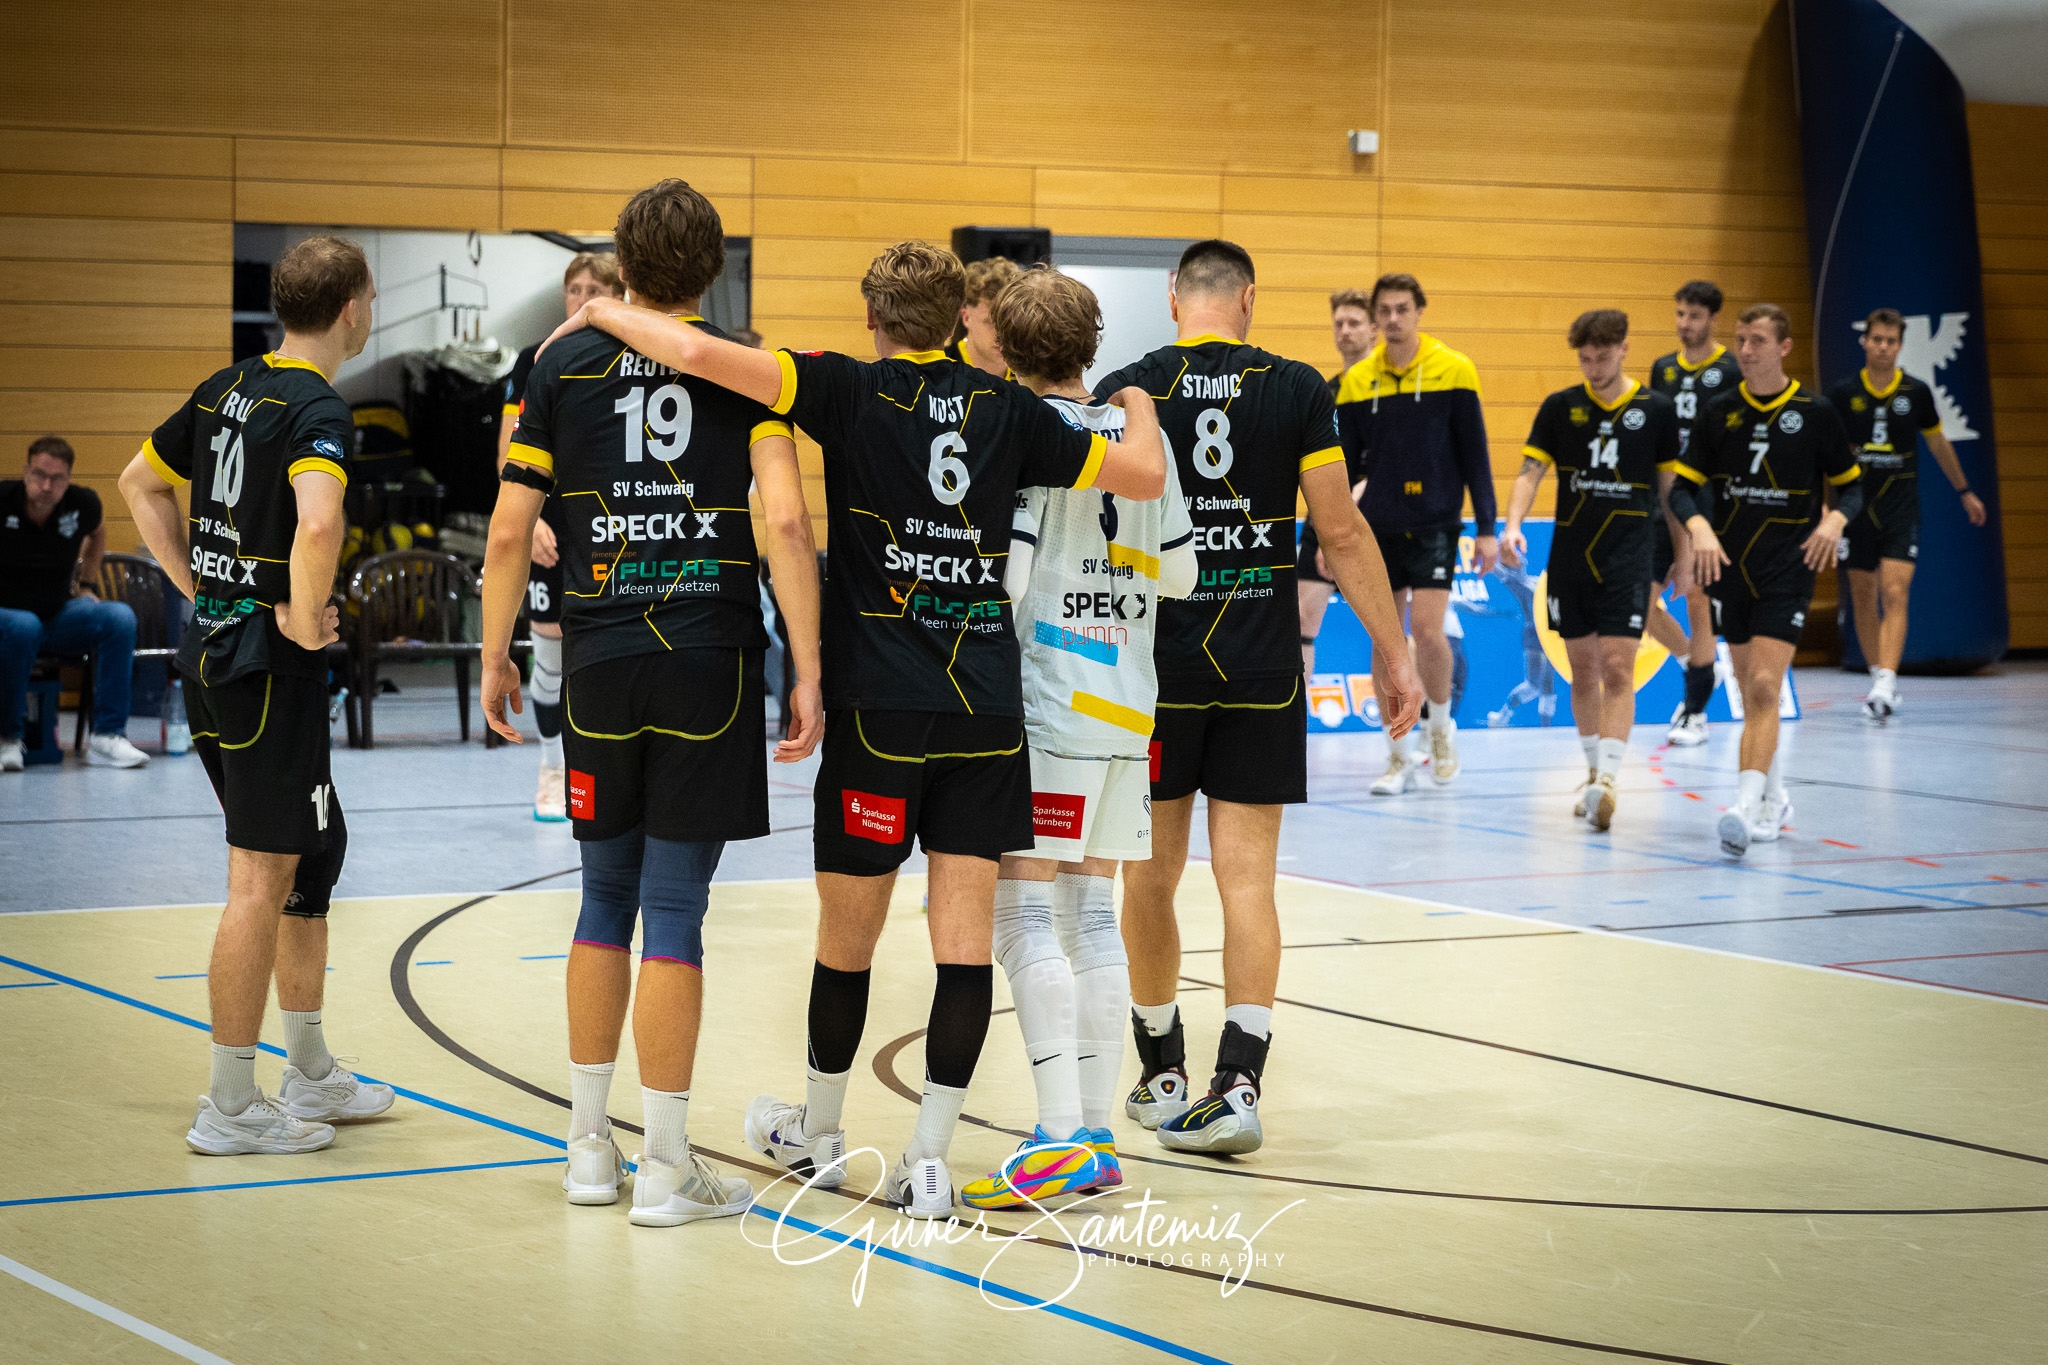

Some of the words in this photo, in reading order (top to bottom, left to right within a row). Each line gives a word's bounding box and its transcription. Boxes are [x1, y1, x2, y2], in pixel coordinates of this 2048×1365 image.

[1182, 374, 1242, 399] STANIC
[1673, 391, 1698, 419] 13
[614, 384, 692, 462] 19
[1872, 420, 1888, 445] 5
[1192, 408, 1234, 480] 8
[1588, 437, 1619, 470] 14
[210, 426, 244, 508] 10
[928, 431, 971, 506] 6
[1748, 442, 1770, 474] 7
[613, 481, 630, 497] SV
[634, 480, 694, 498] Schwaig
[1196, 495, 1250, 512] Schwaig
[199, 516, 212, 533] SV
[591, 513, 687, 543] SPECK
[905, 517, 924, 535] SV
[926, 521, 982, 544] Schwaig
[1194, 525, 1244, 551] ECK
[620, 559, 720, 580] FUCHS
[884, 543, 973, 584] SPECK
[1082, 559, 1098, 574] SV
[1201, 566, 1272, 586] UCHS
[528, 580, 550, 612] 16
[618, 583, 653, 595] Ideen
[657, 580, 720, 593] umsetzen
[1217, 587, 1273, 601] umsetzen
[862, 807, 896, 822] Sparkasse
[1032, 817, 1072, 830] Nürnberg
[1033, 806, 1075, 818] Sparkasse
[862, 818, 893, 835] Nürnberg
